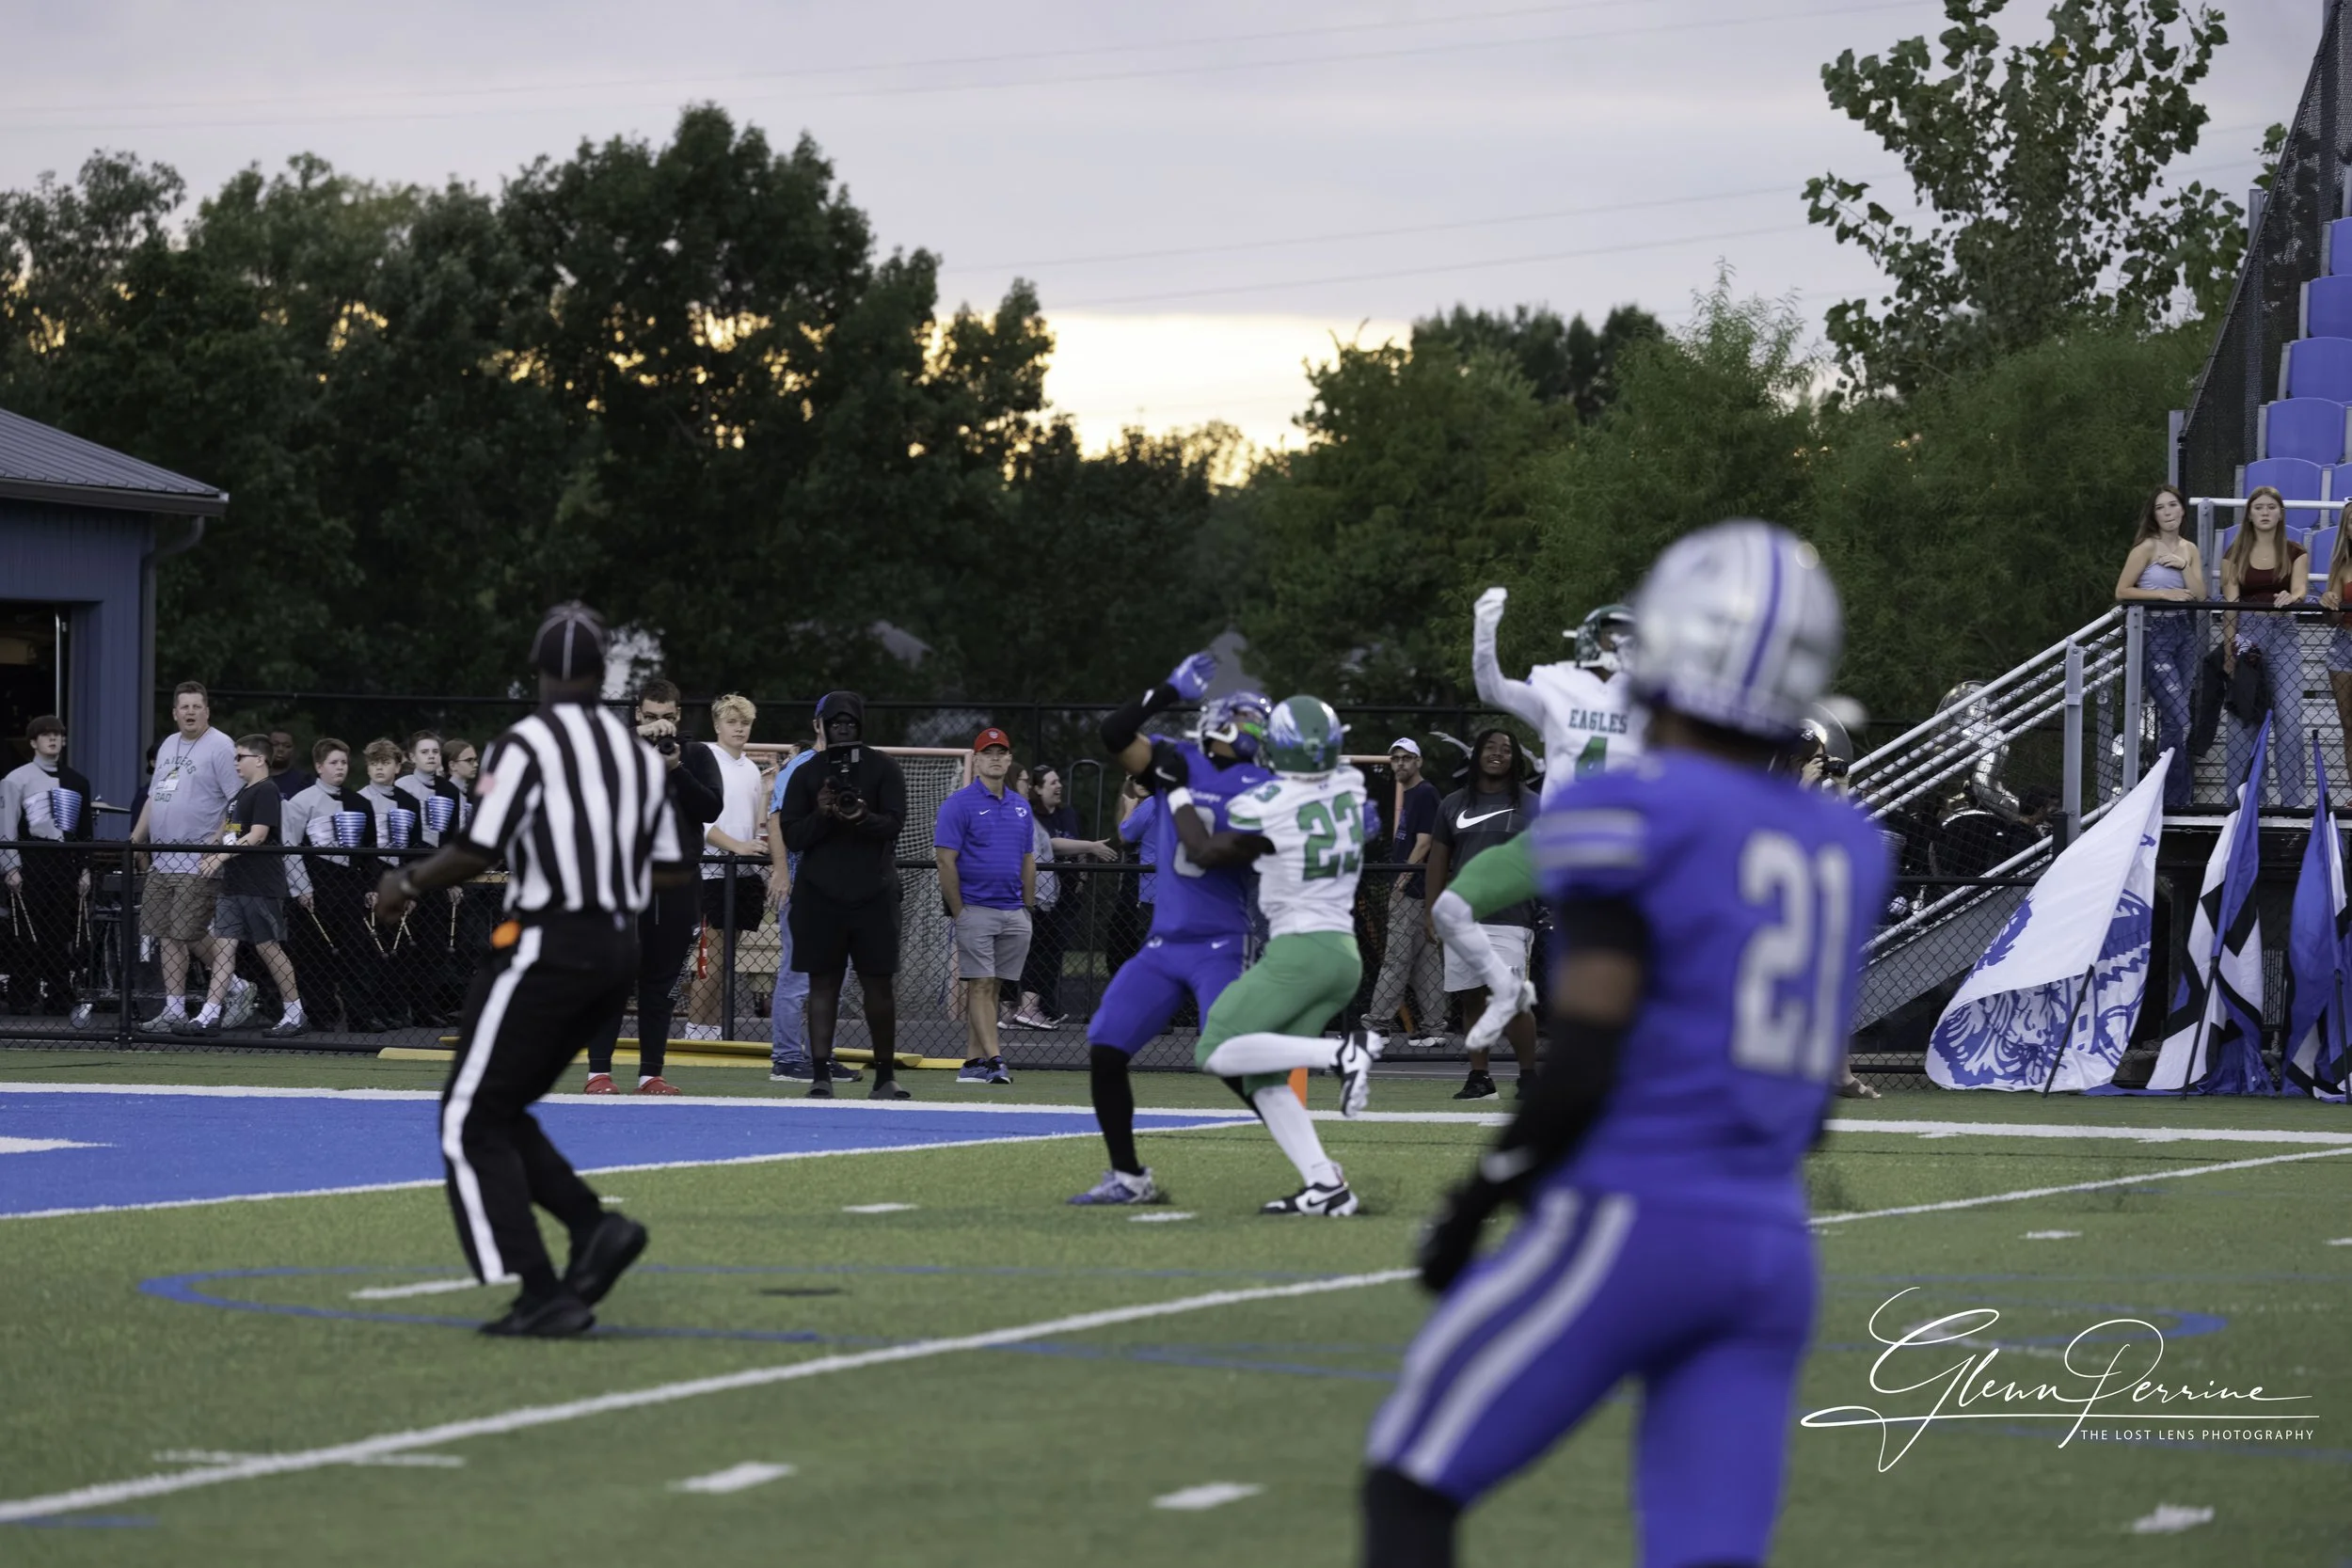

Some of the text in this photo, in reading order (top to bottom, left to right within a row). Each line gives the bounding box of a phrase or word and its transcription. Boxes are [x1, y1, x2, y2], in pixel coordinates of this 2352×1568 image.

[1568, 708, 1629, 735] EAGLES
[1574, 736, 1608, 782] 4
[154, 792, 172, 802] DAD
[1297, 791, 1363, 881] 23
[1733, 828, 1852, 1081] 21
